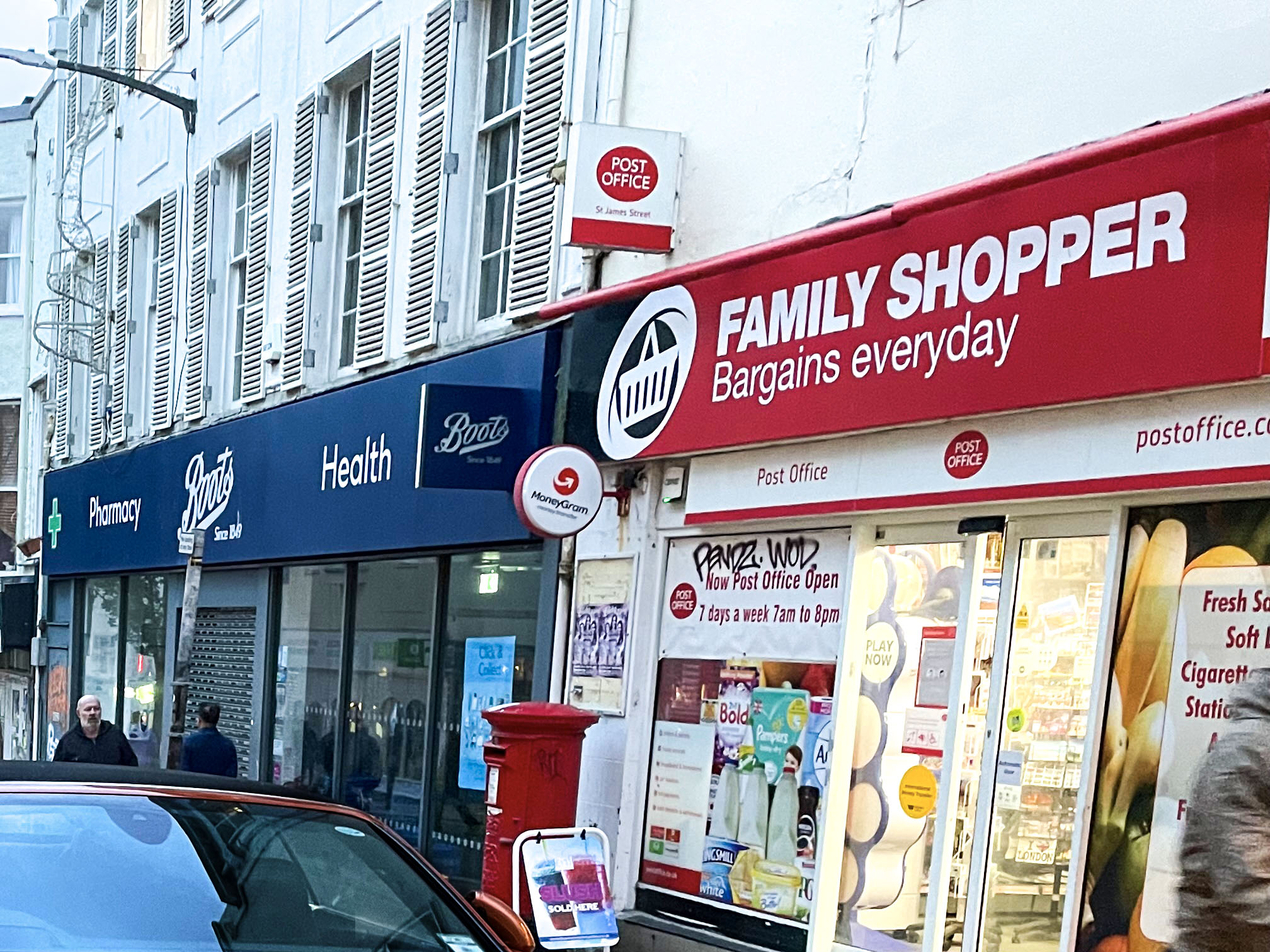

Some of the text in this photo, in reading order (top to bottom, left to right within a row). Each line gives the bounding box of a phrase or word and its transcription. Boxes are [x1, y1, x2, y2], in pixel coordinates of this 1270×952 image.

[611, 156, 648, 173] POST
[601, 171, 651, 190] OFFICE
[605, 206, 627, 217] James
[629, 209, 651, 219] Street
[716, 190, 1188, 357] FAMILY SHOPPER
[711, 310, 1020, 406] Bargains everyday
[434, 411, 510, 456] Boots
[954, 439, 981, 454] POST
[321, 433, 392, 491] Health
[947, 452, 983, 468] OFFICE
[757, 462, 828, 487] Post Office
[177, 446, 234, 542] Boots
[530, 490, 589, 515] MoneyGram
[89, 496, 142, 532] Pharmacy
[705, 569, 839, 593] Now Post Office Open
[675, 589, 693, 600] POST
[1203, 588, 1247, 612] Fresh
[671, 600, 694, 611] OFFICE
[699, 604, 840, 627] 7 days a week 7am to 8pm
[866, 640, 894, 652] PLAY
[1226, 624, 1259, 649] Soft
[865, 653, 892, 666] NOW
[720, 702, 749, 725] Bold
[756, 724, 788, 744] Pampers
[1017, 850, 1054, 863] LONDON
[542, 884, 603, 901] SLUSH
[700, 880, 725, 898] white
[548, 902, 599, 913] SOLD HERE
